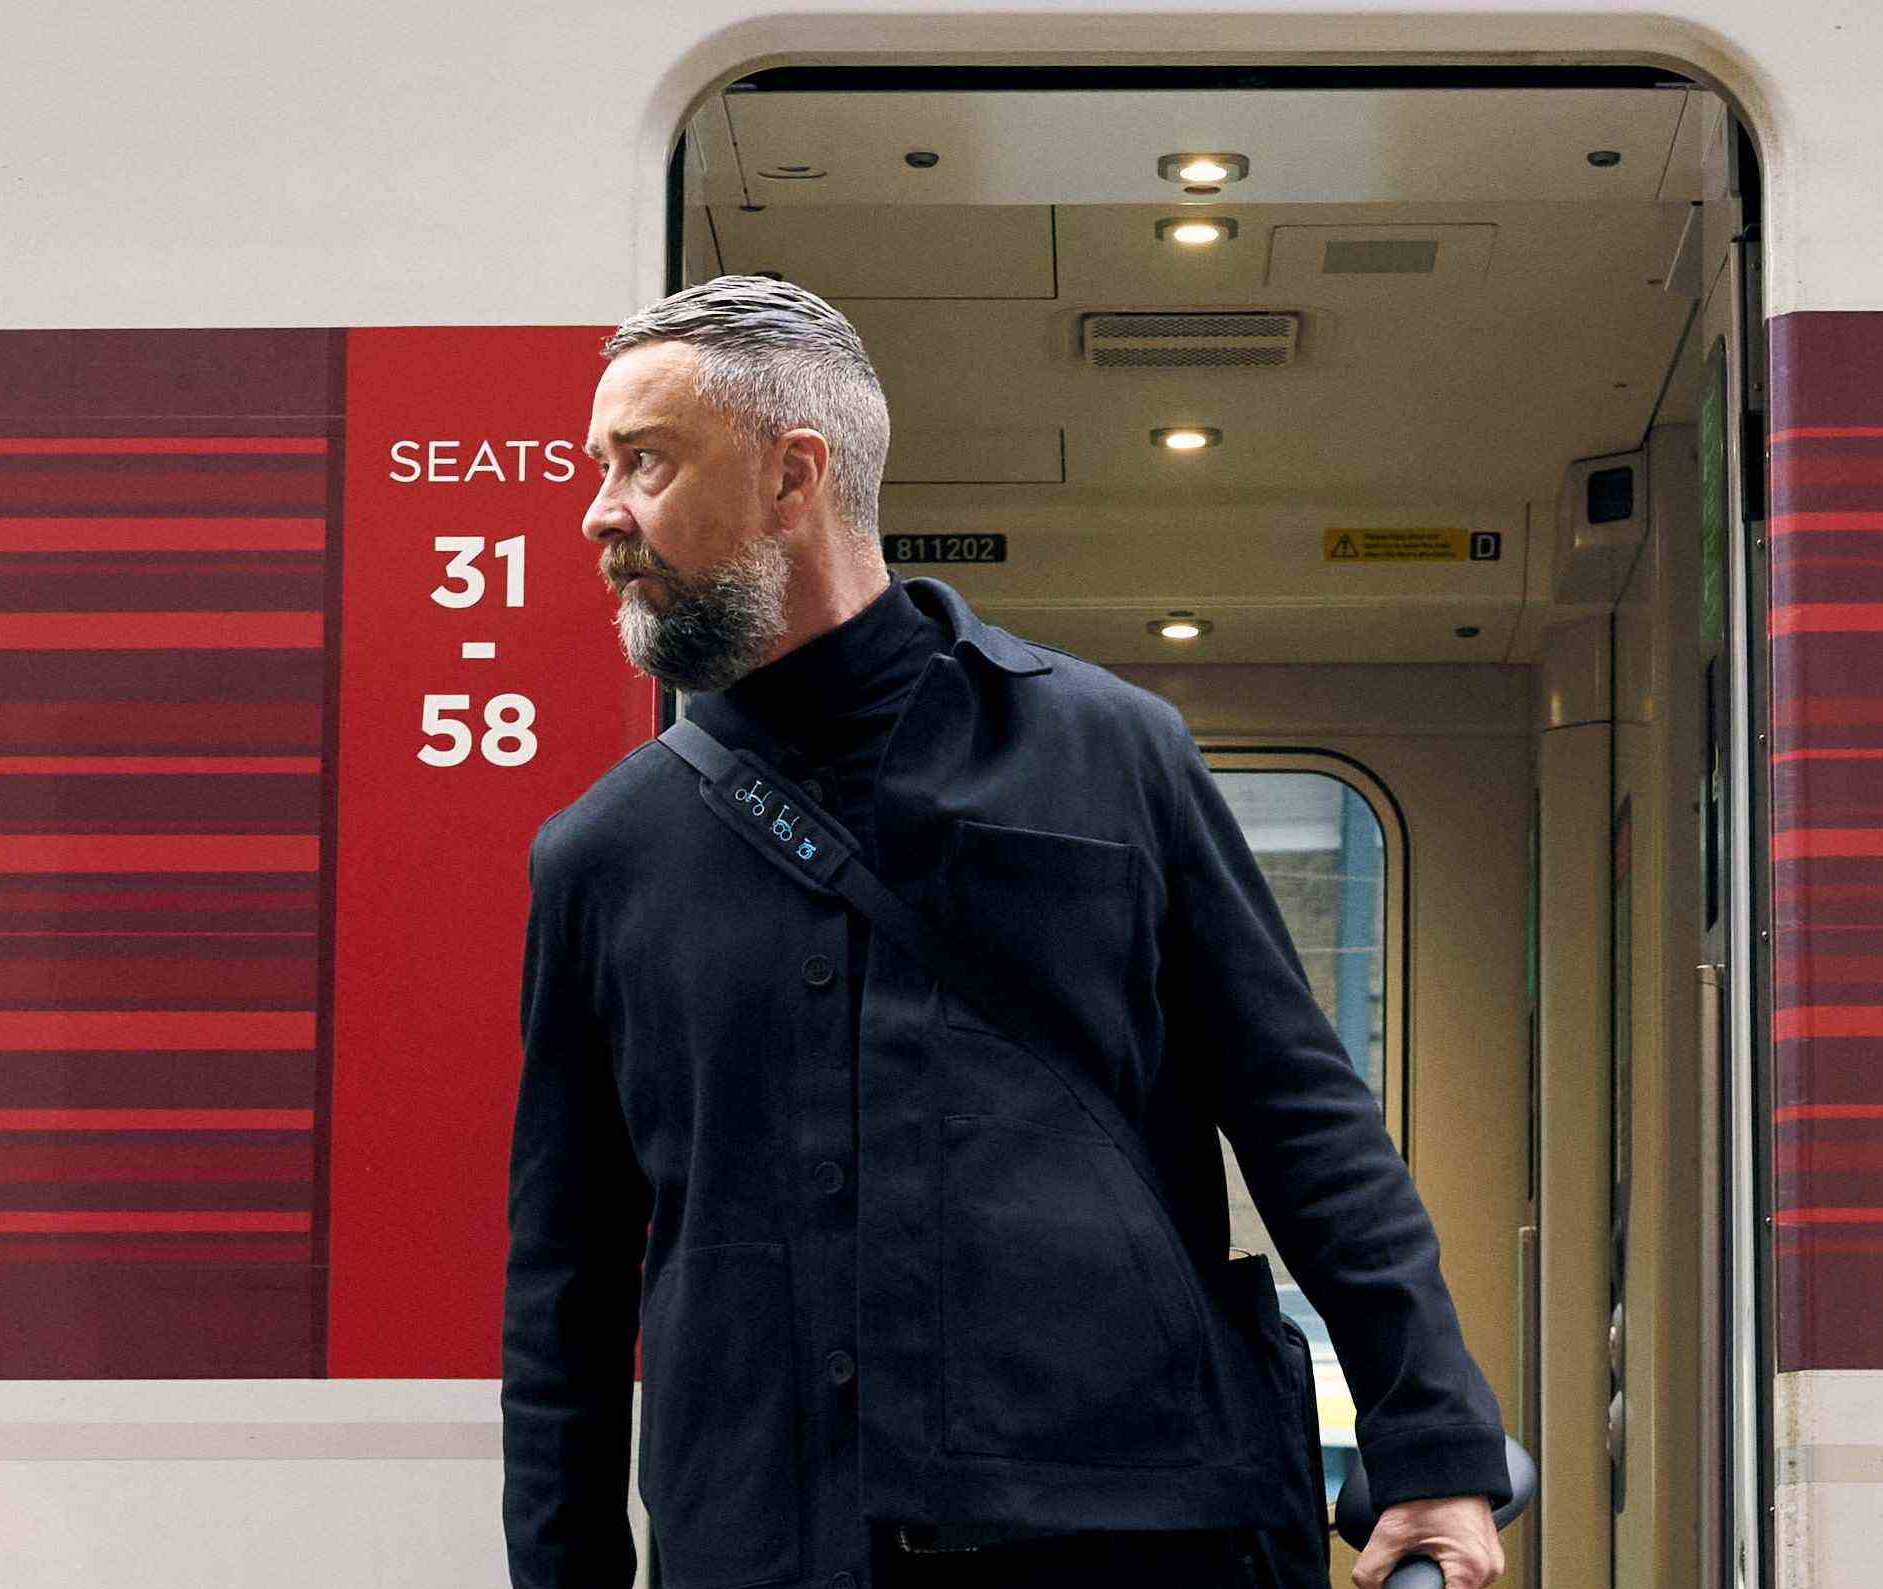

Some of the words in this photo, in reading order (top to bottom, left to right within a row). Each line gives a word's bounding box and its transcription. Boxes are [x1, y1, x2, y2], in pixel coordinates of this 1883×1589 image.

[390, 440, 574, 482] SEATS
[897, 538, 995, 561] 811202
[1476, 534, 1495, 559] D
[431, 535, 525, 608] 31
[418, 694, 537, 766] 58
